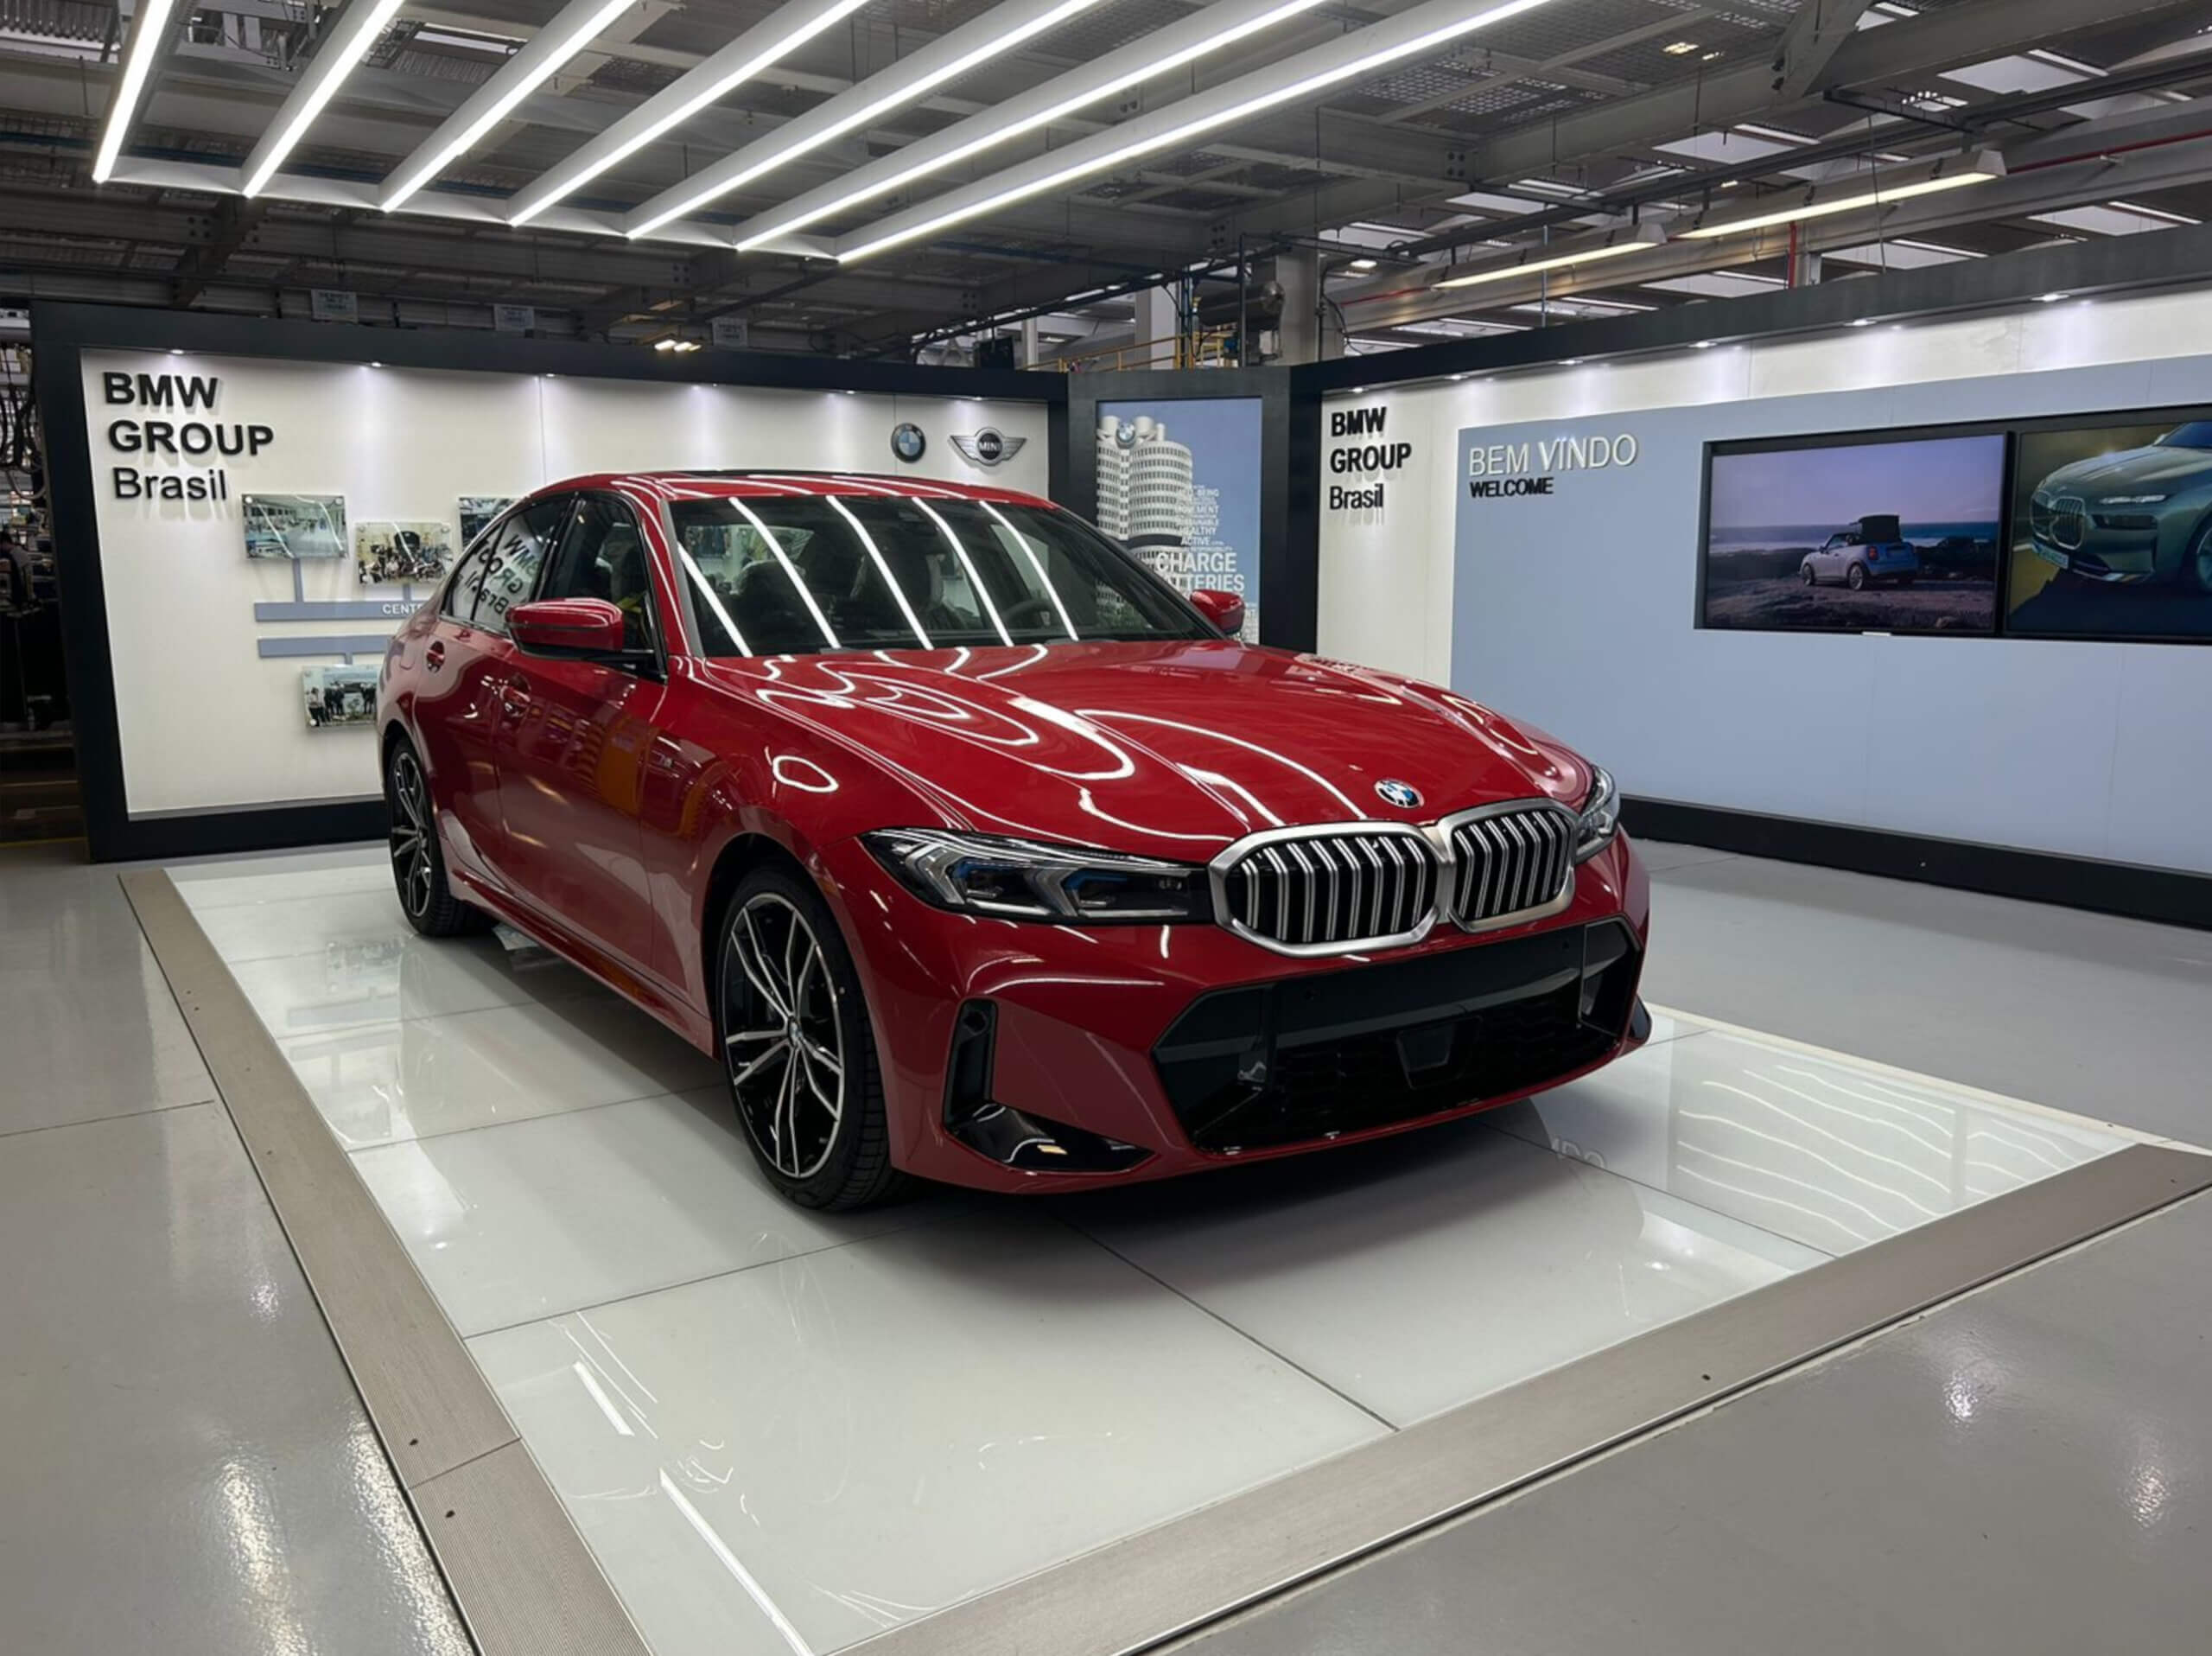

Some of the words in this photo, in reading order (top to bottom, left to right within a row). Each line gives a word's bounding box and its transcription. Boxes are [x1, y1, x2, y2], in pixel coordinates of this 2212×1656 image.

[103, 372, 219, 409] BMW
[1331, 406, 1387, 437] BMW
[108, 419, 275, 456] GROUP
[1330, 443, 1413, 474] GROUP
[1469, 441, 1530, 478] BEM
[1539, 433, 1640, 472] VINDO
[111, 467, 227, 501] Brasil
[1329, 482, 1384, 511] Brasil
[1469, 477, 1554, 499] WELCOME
[1180, 536, 1211, 546] ACTIVE
[1155, 551, 1237, 573] CHARGE
[1166, 573, 1245, 592] TTERIES
